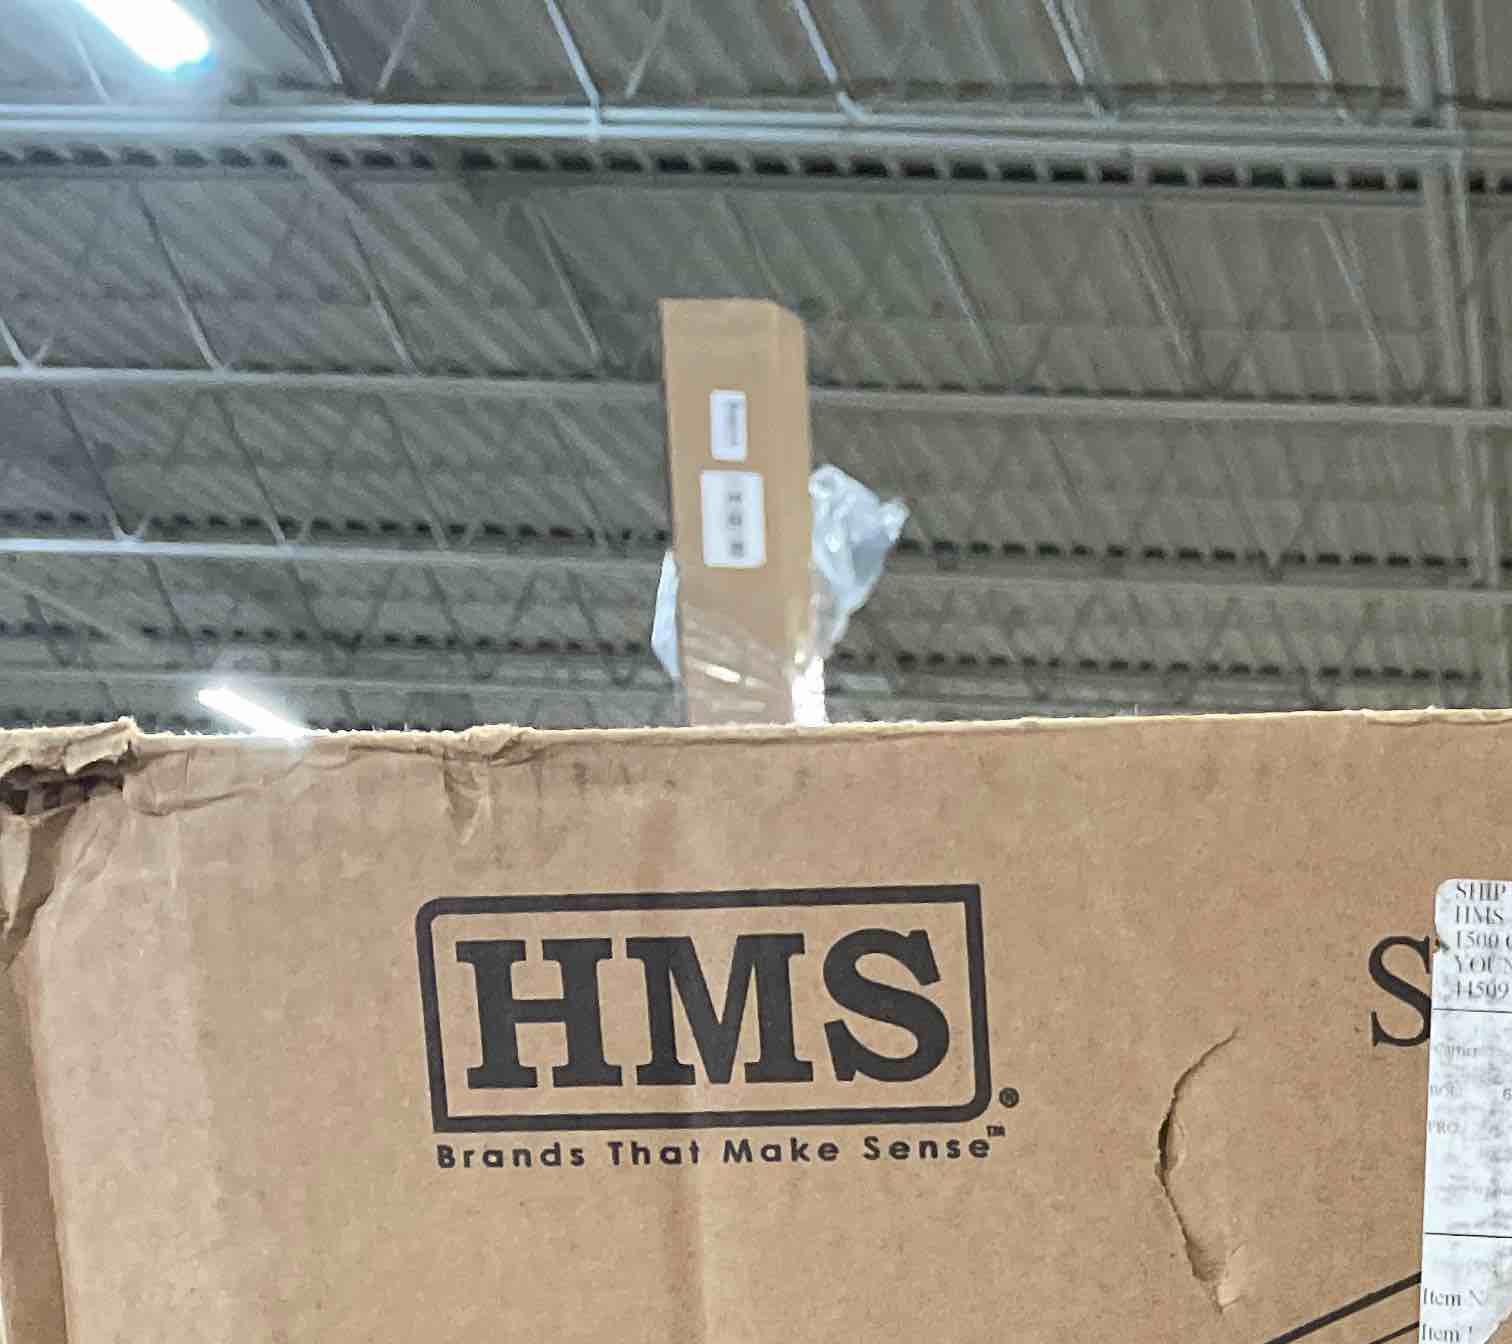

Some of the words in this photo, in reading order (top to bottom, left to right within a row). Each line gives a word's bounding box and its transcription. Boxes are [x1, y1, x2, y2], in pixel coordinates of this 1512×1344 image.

[455, 928, 950, 1089] HMS
[437, 1143, 585, 1169] Brands
[608, 1140, 701, 1166] That
[722, 1136, 840, 1164] Make
[1423, 1287, 1461, 1306] Item
[1422, 1323, 1460, 1343] Item
